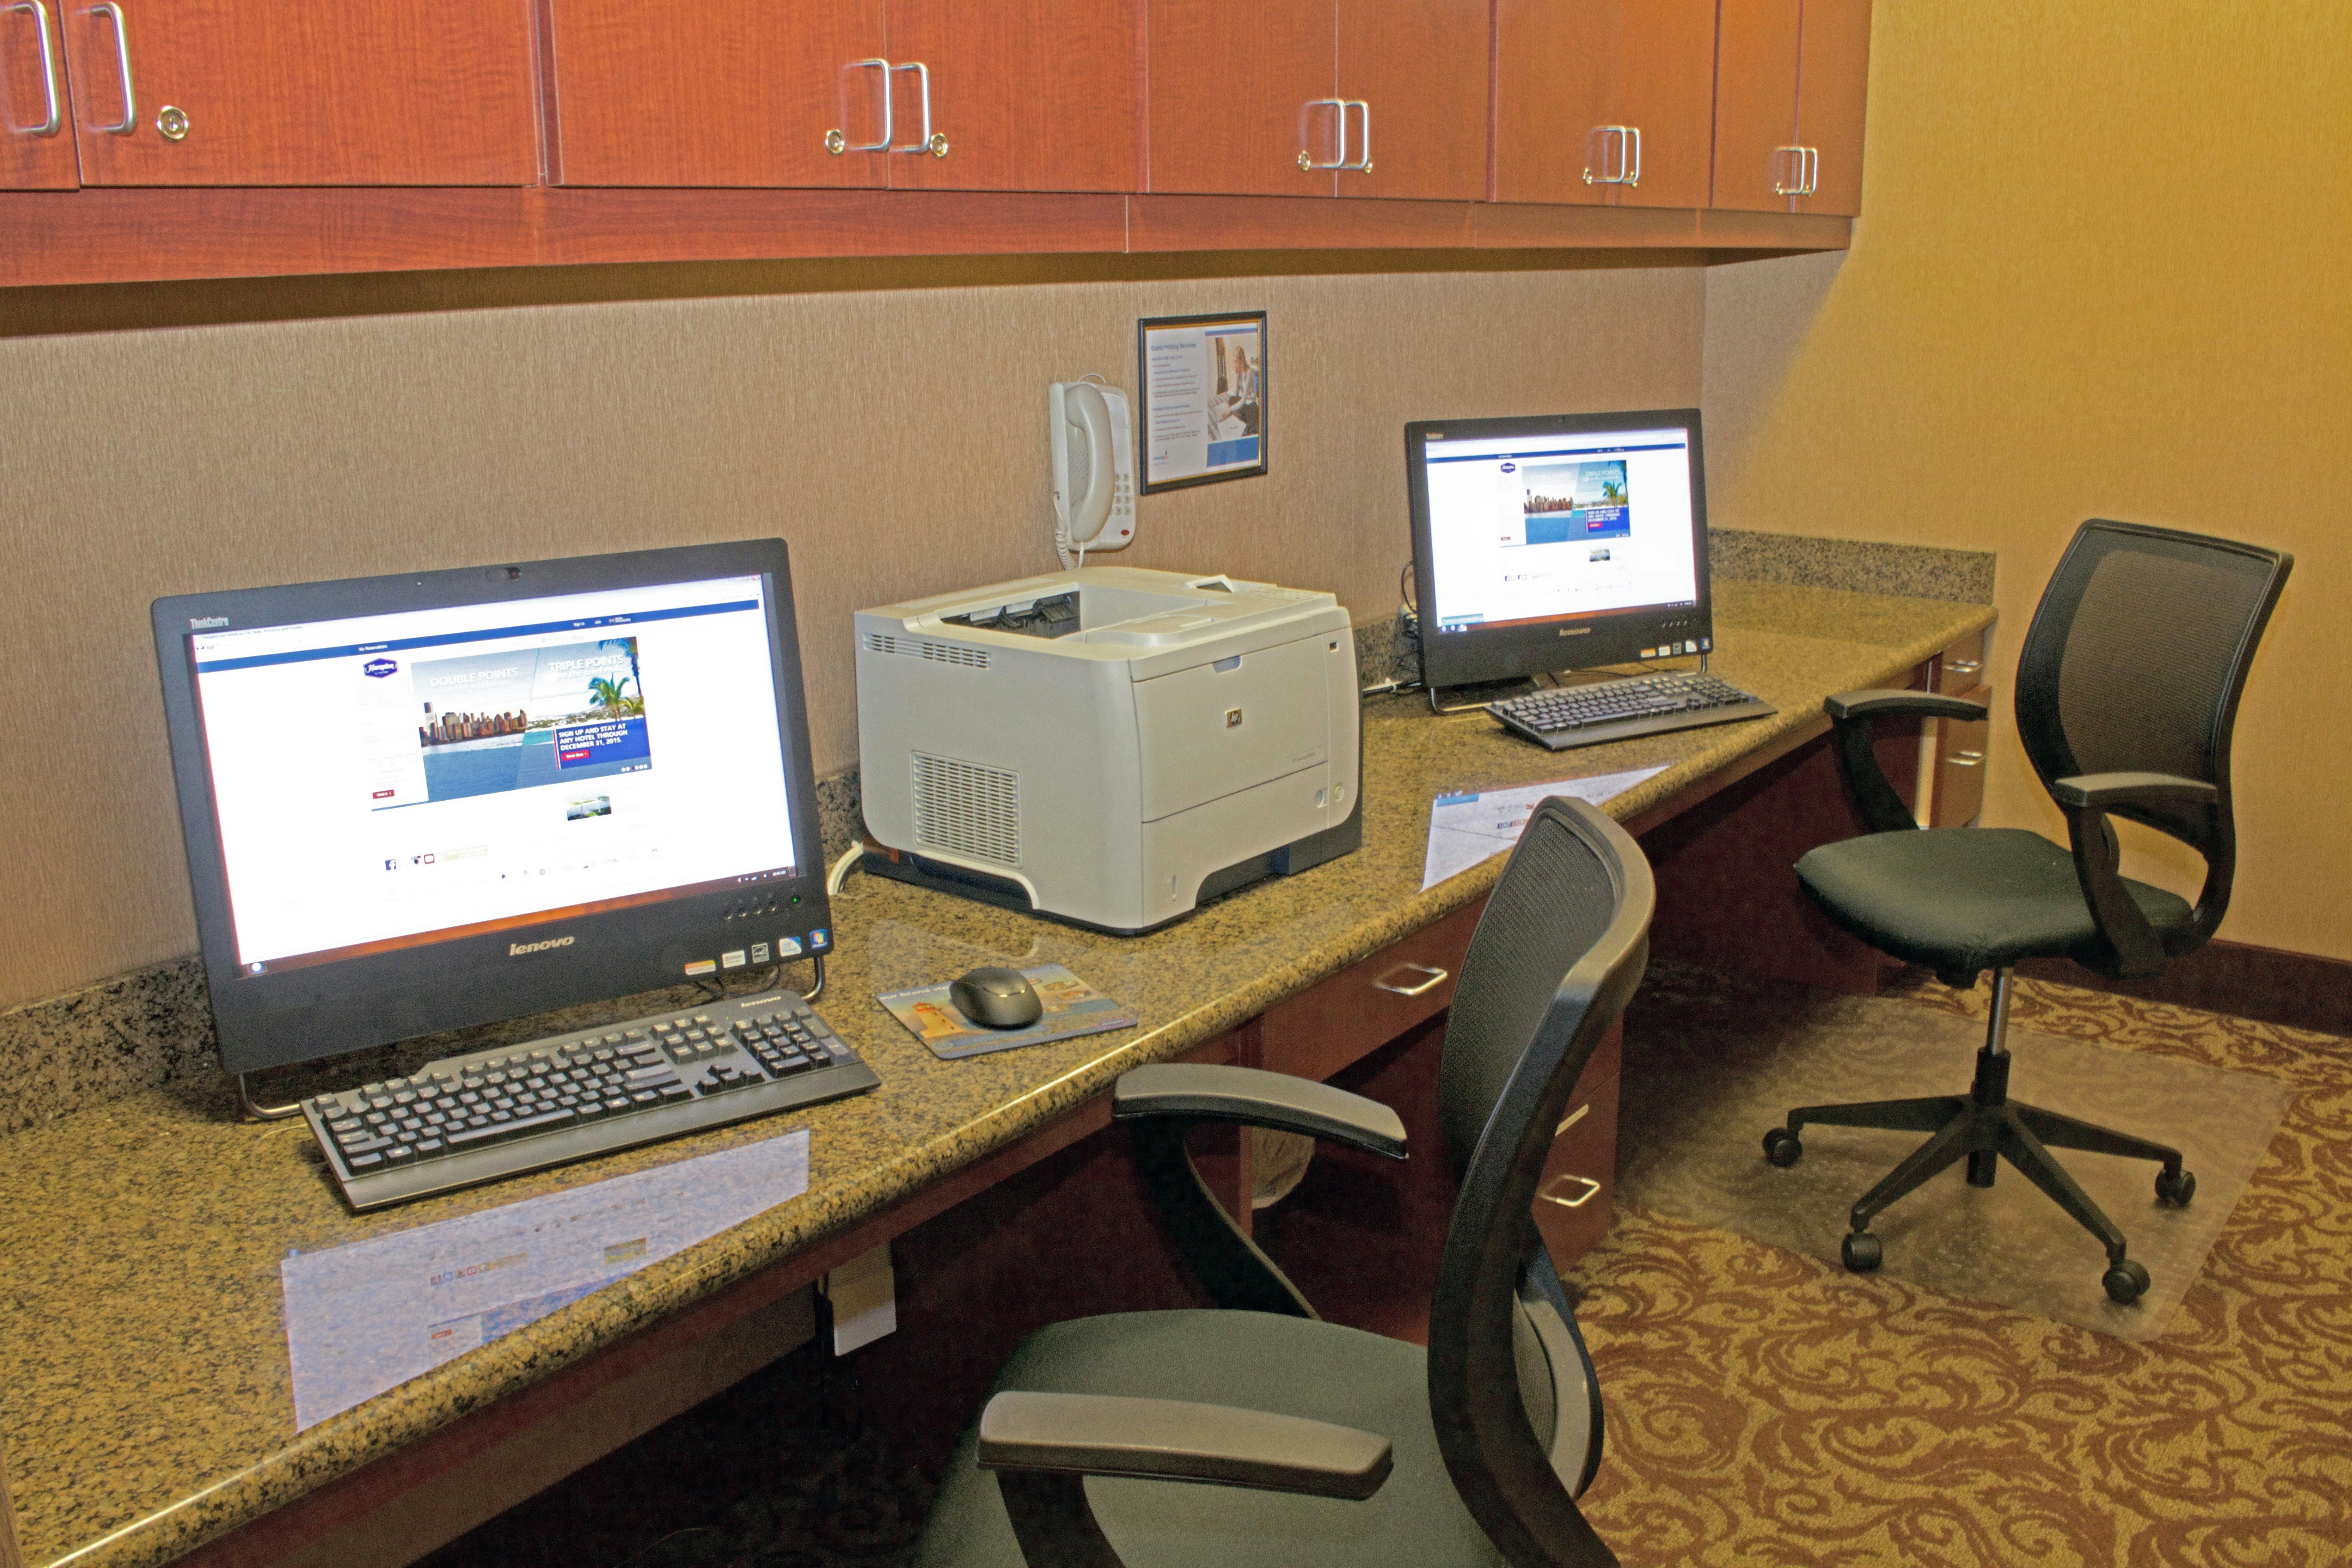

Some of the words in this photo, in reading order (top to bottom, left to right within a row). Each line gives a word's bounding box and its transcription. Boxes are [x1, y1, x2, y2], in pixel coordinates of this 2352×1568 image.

[190, 617, 229, 629] ThinkCentre
[1559, 628, 1591, 637] lenovo
[365, 663, 397, 674] Hampton
[548, 658, 584, 672] TRIPLE
[585, 654, 624, 668] POINTS
[431, 672, 476, 688] DOUBLE
[478, 667, 519, 681] POINTS
[1231, 712, 1238, 724] hp
[575, 734, 596, 742] HOTEL
[597, 730, 628, 739] THROUGH
[560, 740, 594, 751] DECEMBER
[509, 936, 575, 956] lenovo
[741, 996, 782, 1008] lenovo
